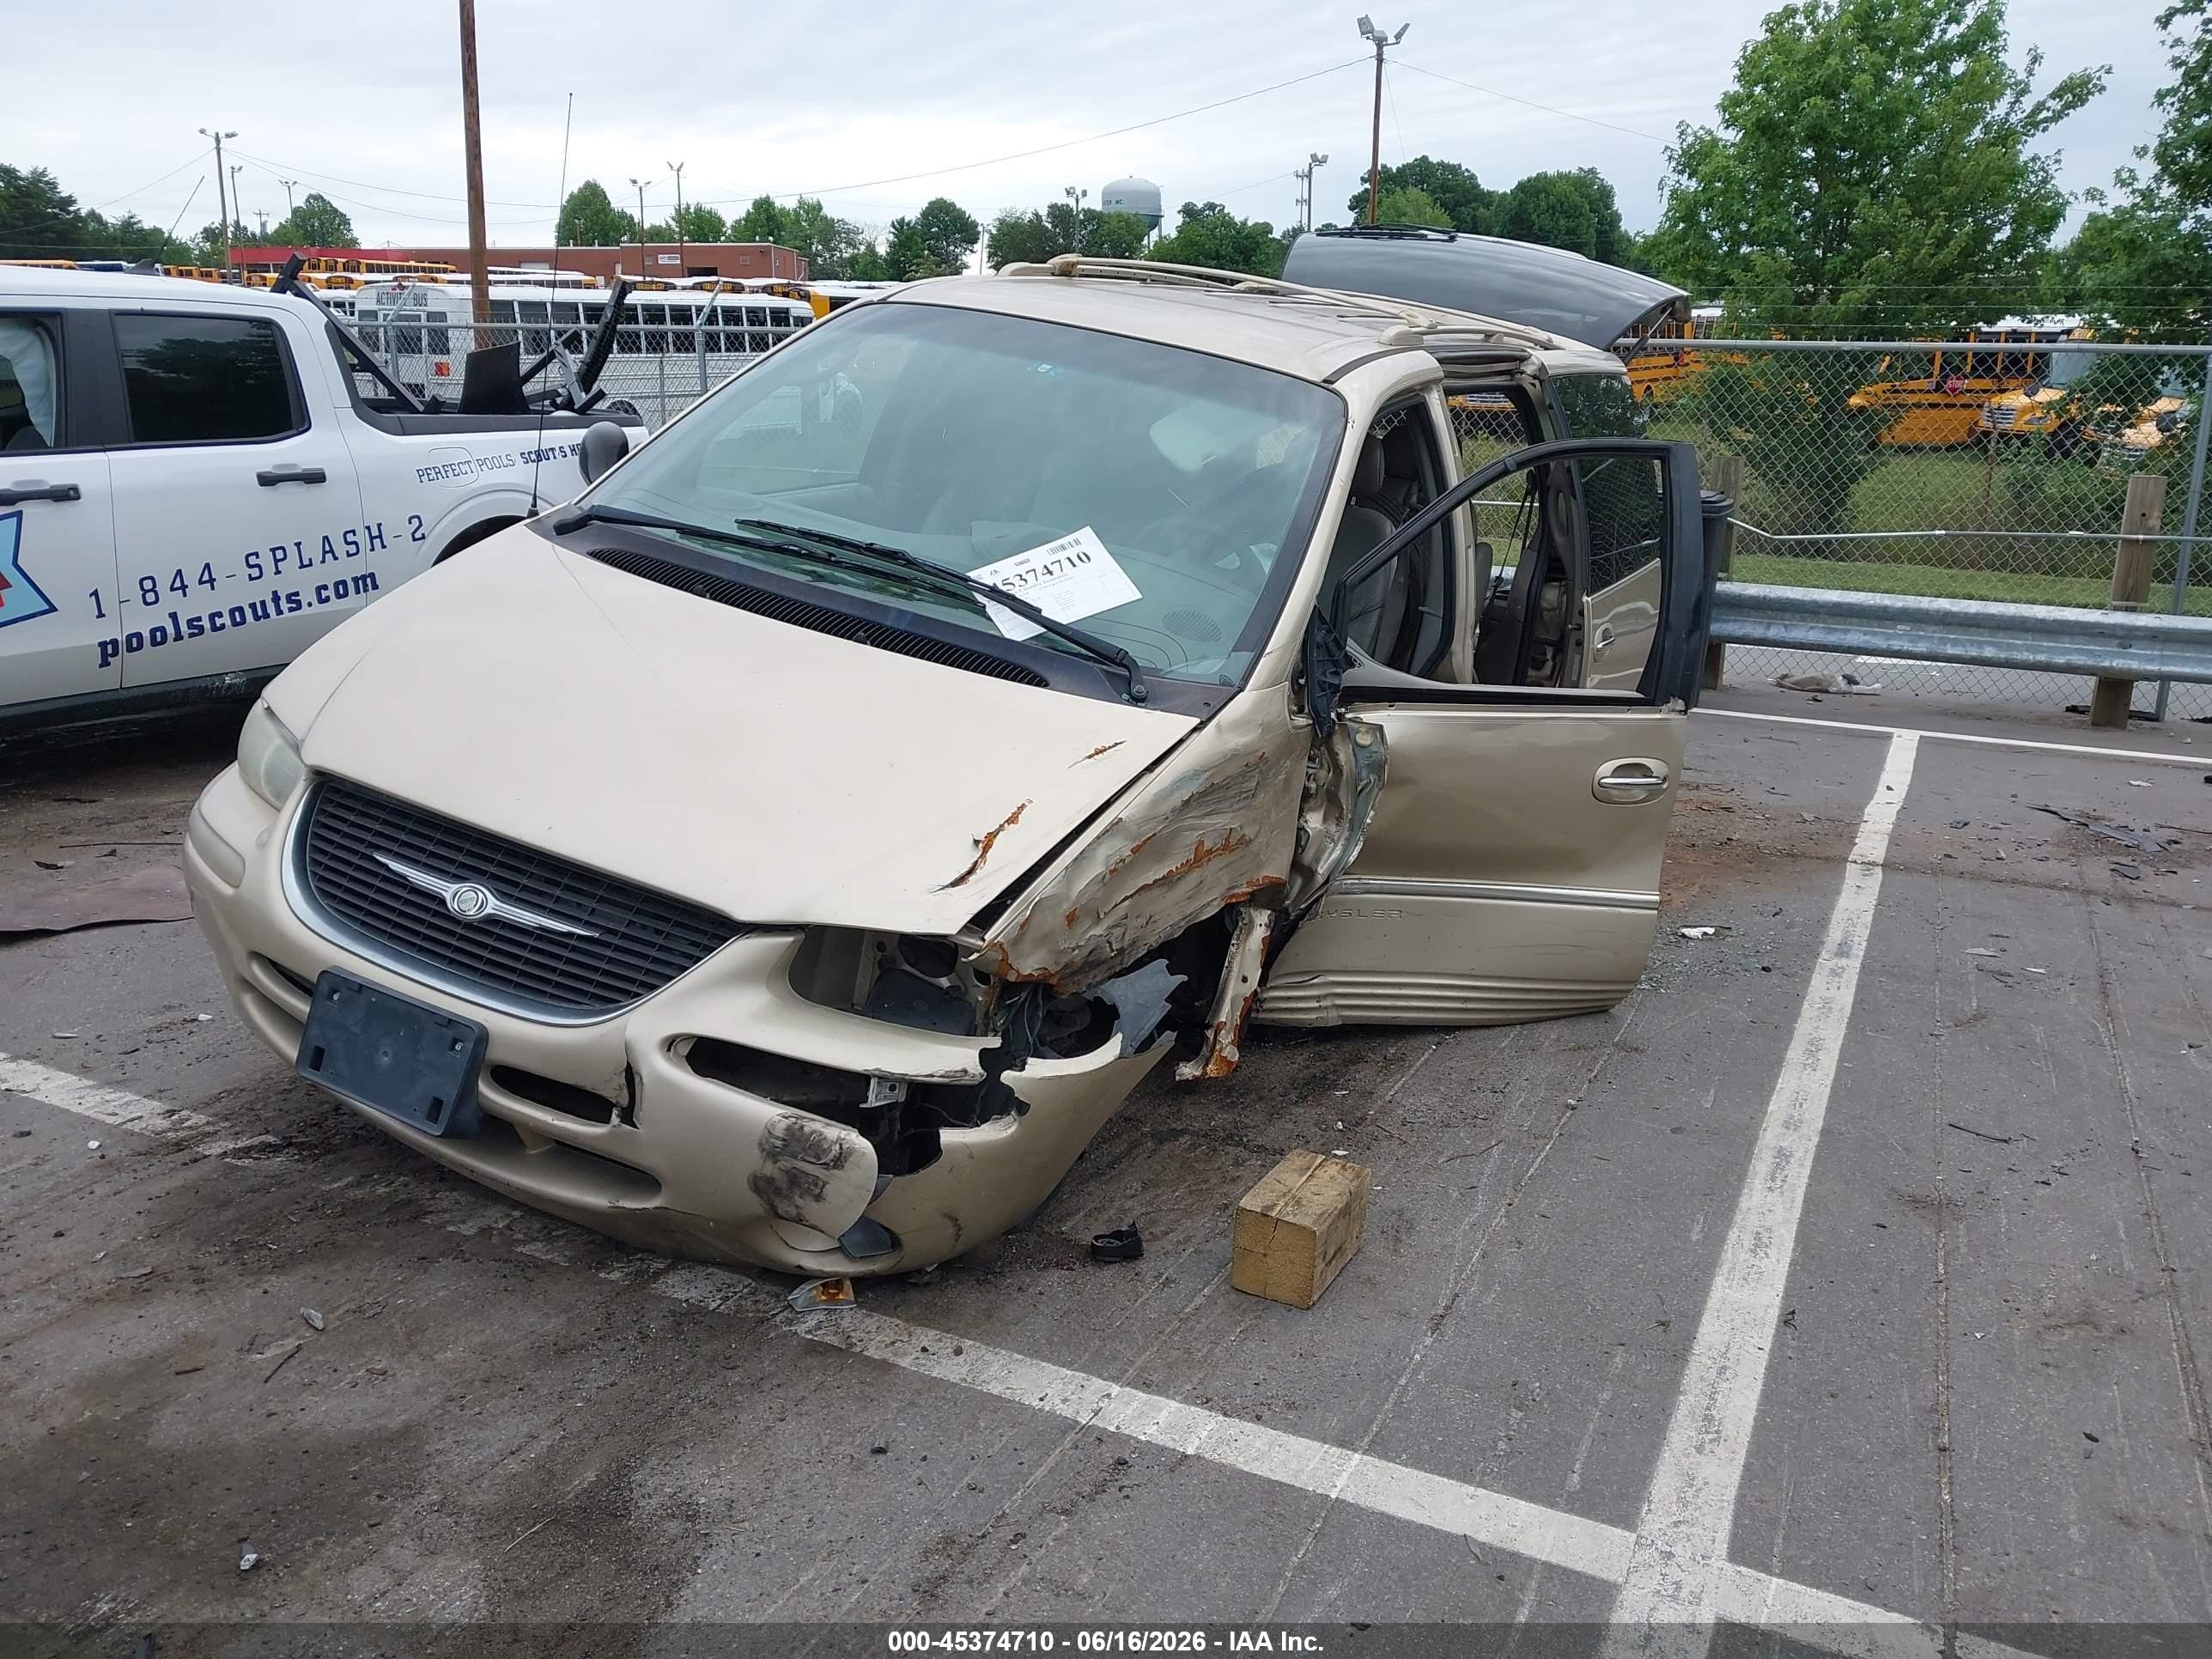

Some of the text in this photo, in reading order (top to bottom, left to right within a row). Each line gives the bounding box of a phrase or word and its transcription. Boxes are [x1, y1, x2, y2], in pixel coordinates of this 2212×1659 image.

[413, 293, 428, 307] BUS
[416, 459, 474, 483] PERFECT
[88, 514, 427, 619] 1-844-SPLASH-2
[97, 570, 380, 668] poolscouts.com
